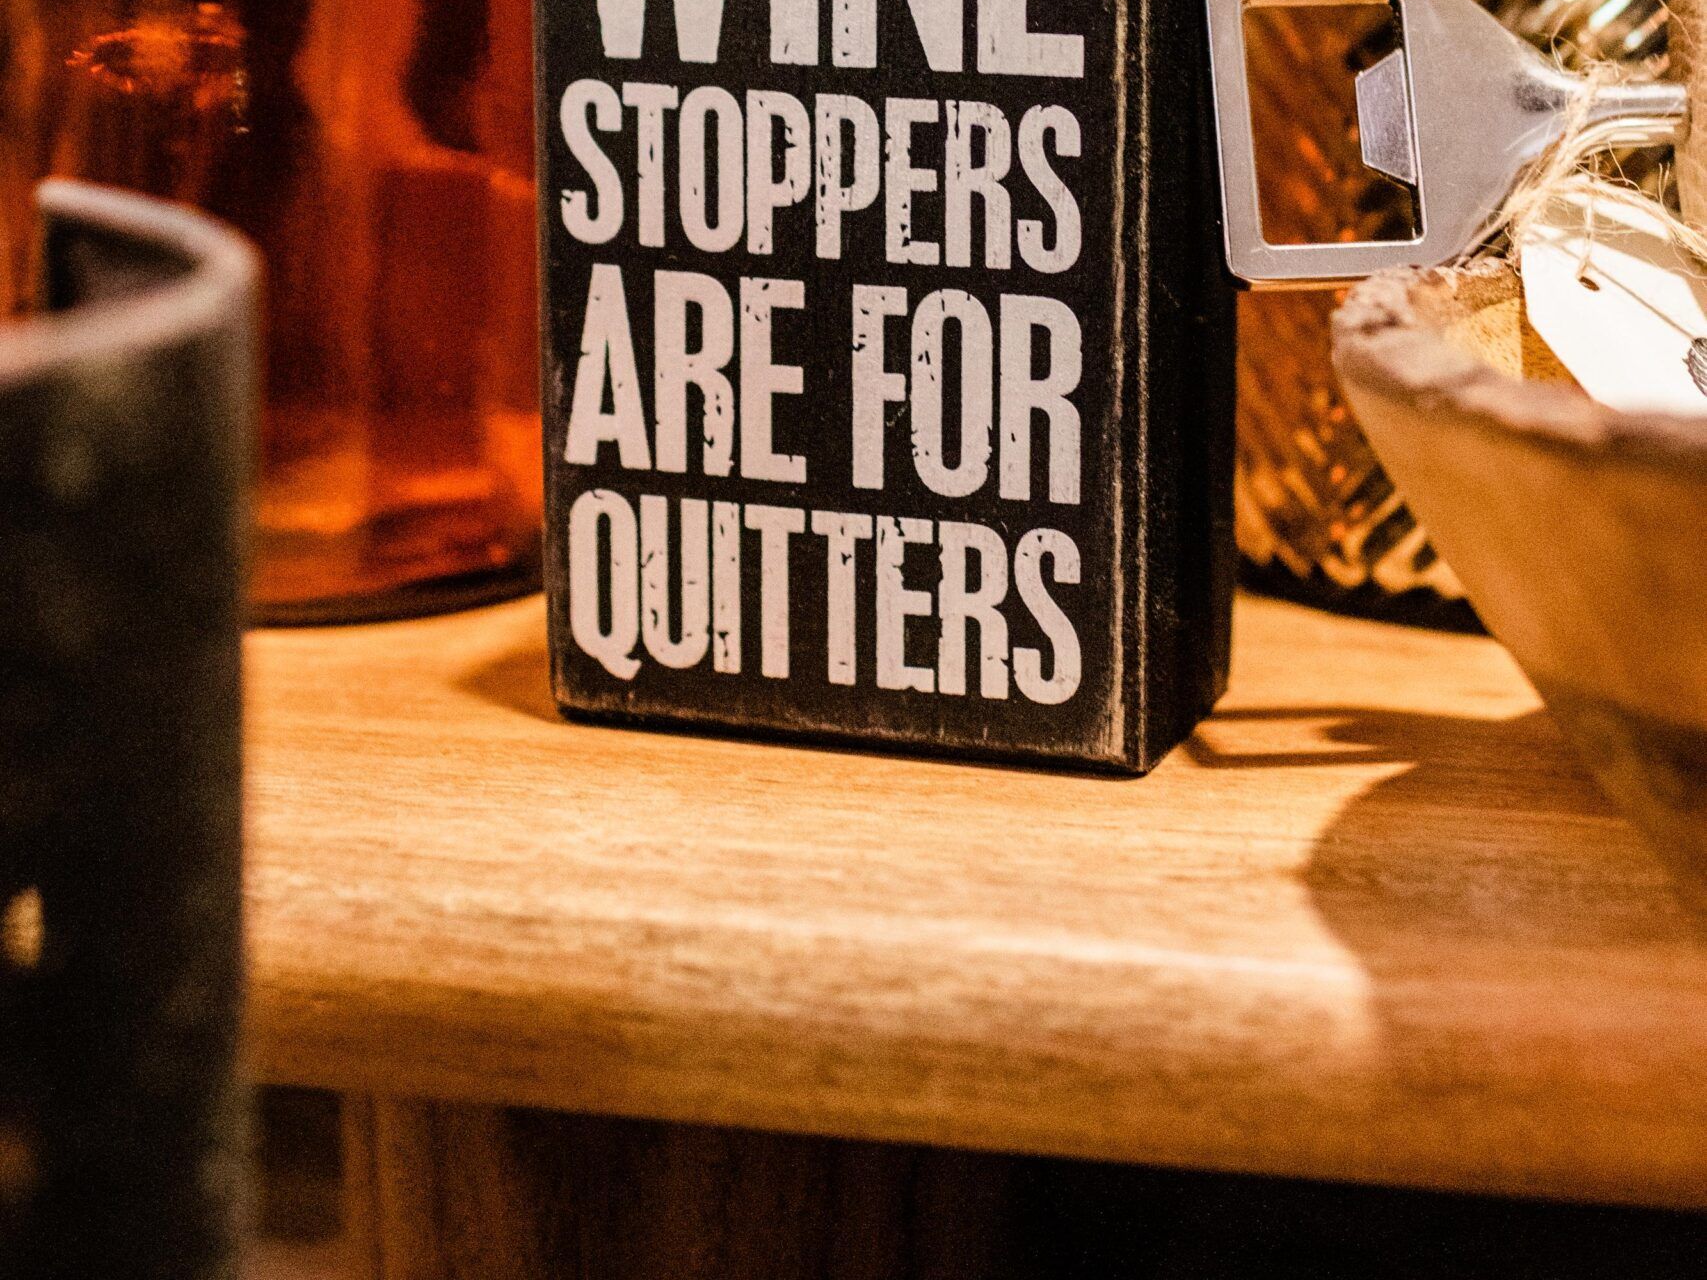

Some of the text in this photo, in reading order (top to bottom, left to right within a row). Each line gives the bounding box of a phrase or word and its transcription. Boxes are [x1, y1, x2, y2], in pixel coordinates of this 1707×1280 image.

[559, 78, 1082, 274] STOPPERS
[564, 263, 1083, 505] ARE FOR
[568, 488, 1082, 705] QUITTERS
